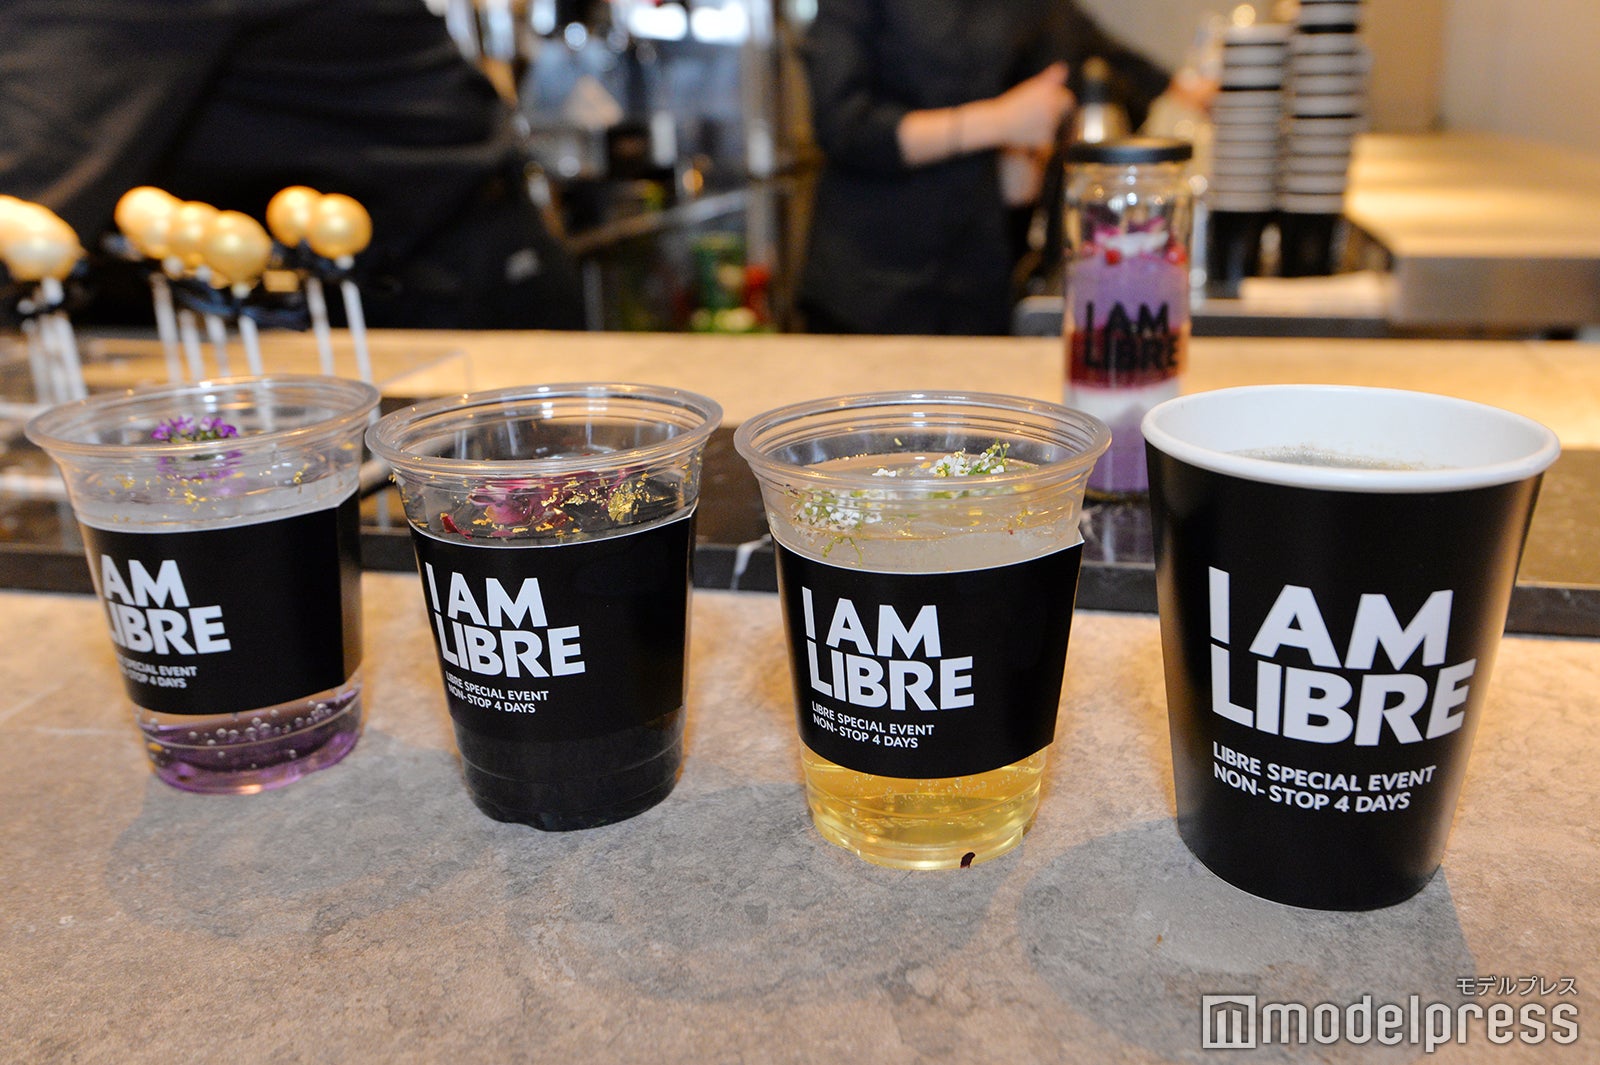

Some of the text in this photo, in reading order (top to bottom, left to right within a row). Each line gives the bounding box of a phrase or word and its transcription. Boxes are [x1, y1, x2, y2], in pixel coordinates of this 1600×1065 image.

[1086, 301, 1169, 336] I AM
[1084, 332, 1178, 372] LIBRE
[101, 553, 190, 608] AM
[425, 561, 548, 629] I AM
[801, 585, 942, 660] I AM
[1208, 565, 1454, 671] I AM
[434, 612, 586, 678] LIBRE
[157, 676, 187, 689] DAYS
[158, 665, 197, 677] EVENT
[445, 670, 549, 701] LIBRE SPECIAL EVENT
[806, 639, 975, 711] LIBRE
[1210, 643, 1477, 746] LIBRE
[447, 682, 536, 714] NON-STOP 4 DAYS
[811, 700, 935, 736] LIBRE SPECIAL EVENT
[812, 713, 919, 748] NON-STOP 4 DAYS
[1212, 741, 1437, 792] LIBRE SPECIAL EVENT
[1213, 761, 1411, 813] NON-STOP 4 DAYS
